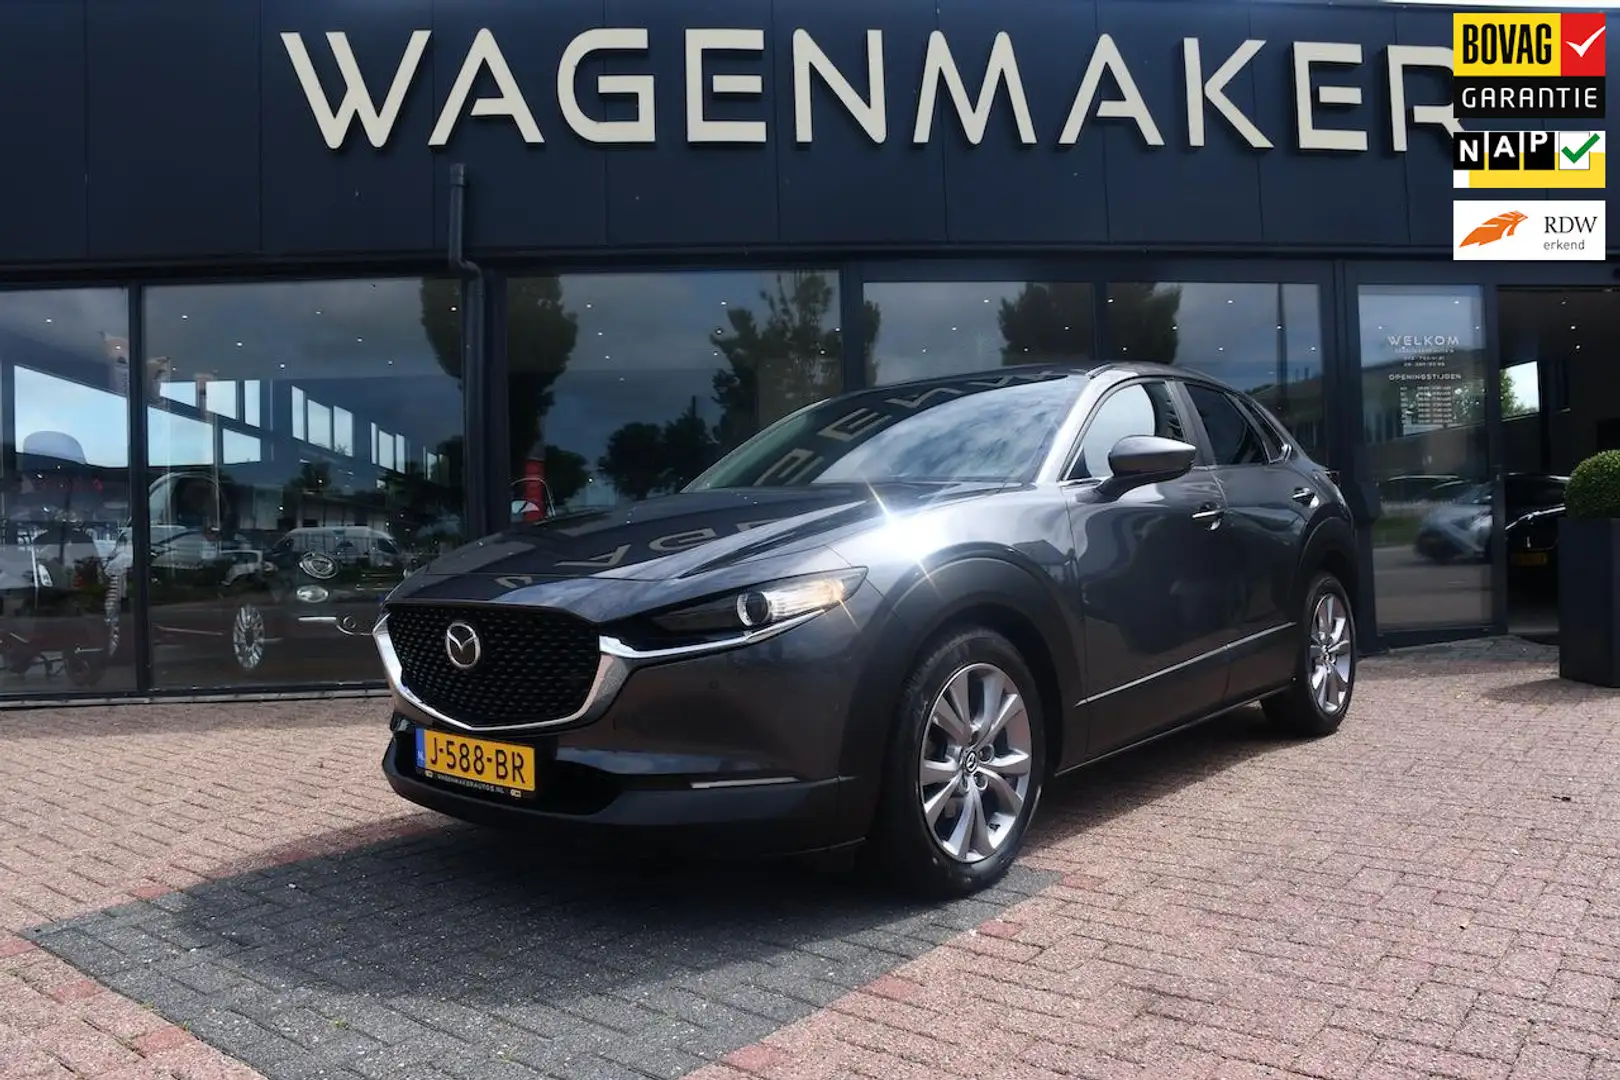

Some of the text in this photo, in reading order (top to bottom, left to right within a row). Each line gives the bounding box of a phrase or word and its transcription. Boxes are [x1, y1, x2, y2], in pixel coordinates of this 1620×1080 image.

[281, 28, 1467, 152] WAGENMAKER
[1387, 335, 1460, 346] WELKOM
[1388, 373, 1461, 381] OPENINGSTIJDEN
[430, 736, 526, 785] J-588-BR
